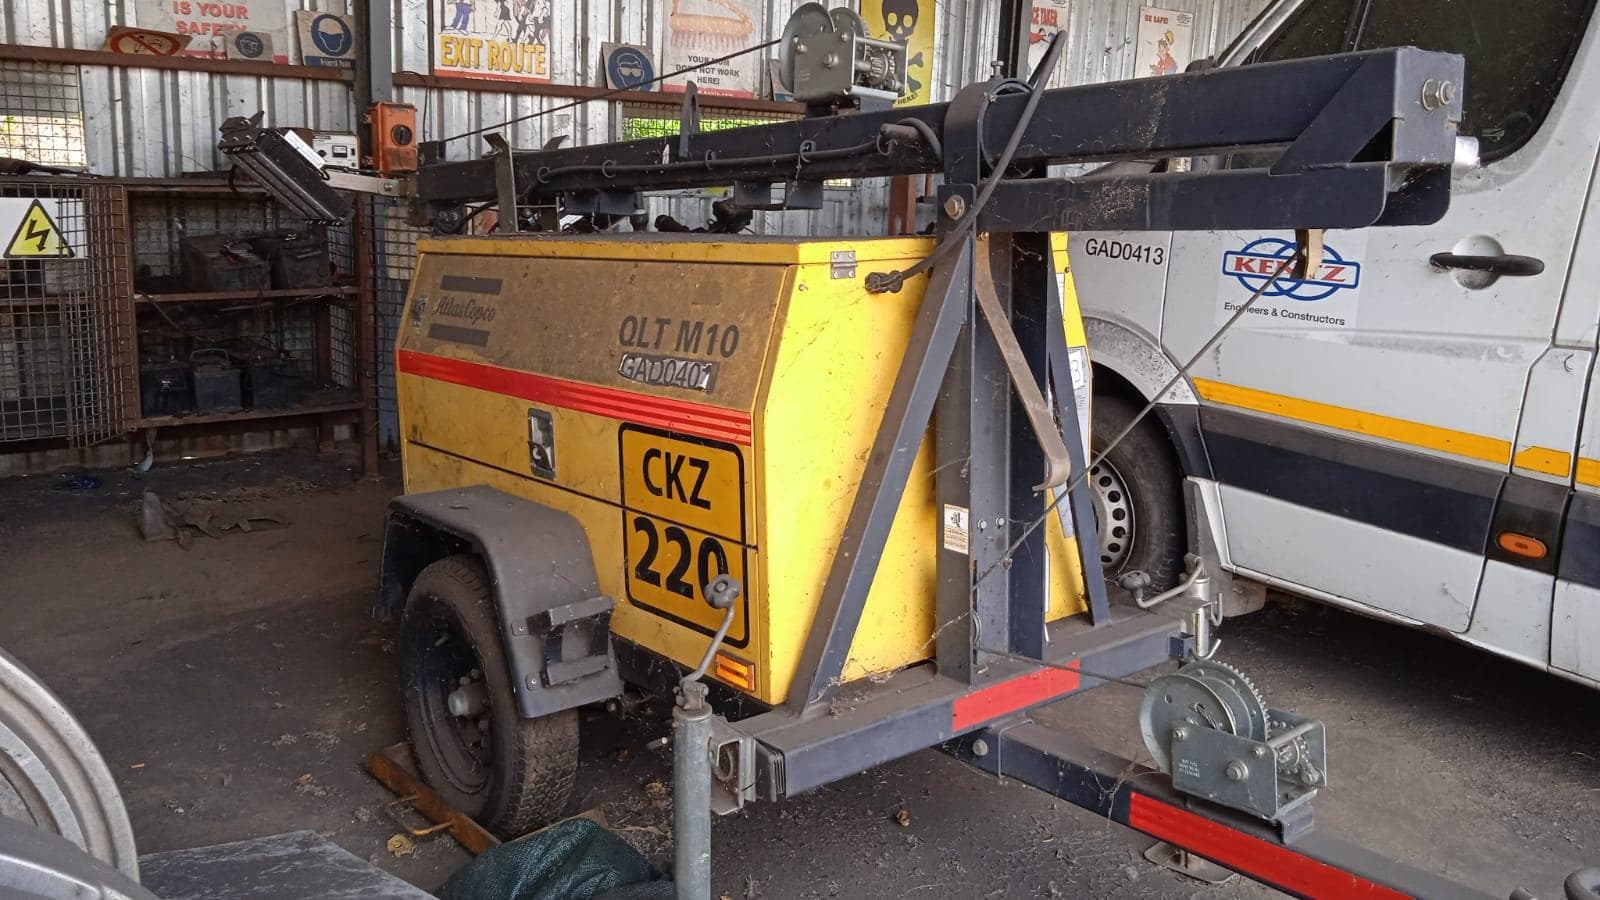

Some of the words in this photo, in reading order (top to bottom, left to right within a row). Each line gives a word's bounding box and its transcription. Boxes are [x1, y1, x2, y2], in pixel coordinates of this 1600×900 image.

[173, 0, 192, 15] IS
[196, 2, 249, 19] YOUR
[441, 35, 483, 69] EXIT
[487, 39, 546, 75] ROUTE
[688, 55, 710, 64] YOUR
[717, 67, 739, 77] WORK
[1085, 238, 1164, 265] GAD0413
[1233, 256, 1346, 282] KEZ
[1224, 301, 1269, 316] Engeers
[1271, 307, 1279, 317] &
[1280, 309, 1346, 326] Constructors
[618, 315, 672, 350] QLT
[674, 321, 740, 358] M10
[620, 354, 713, 391] GAD0401
[642, 448, 711, 510] CKZ
[633, 516, 729, 609] 220
